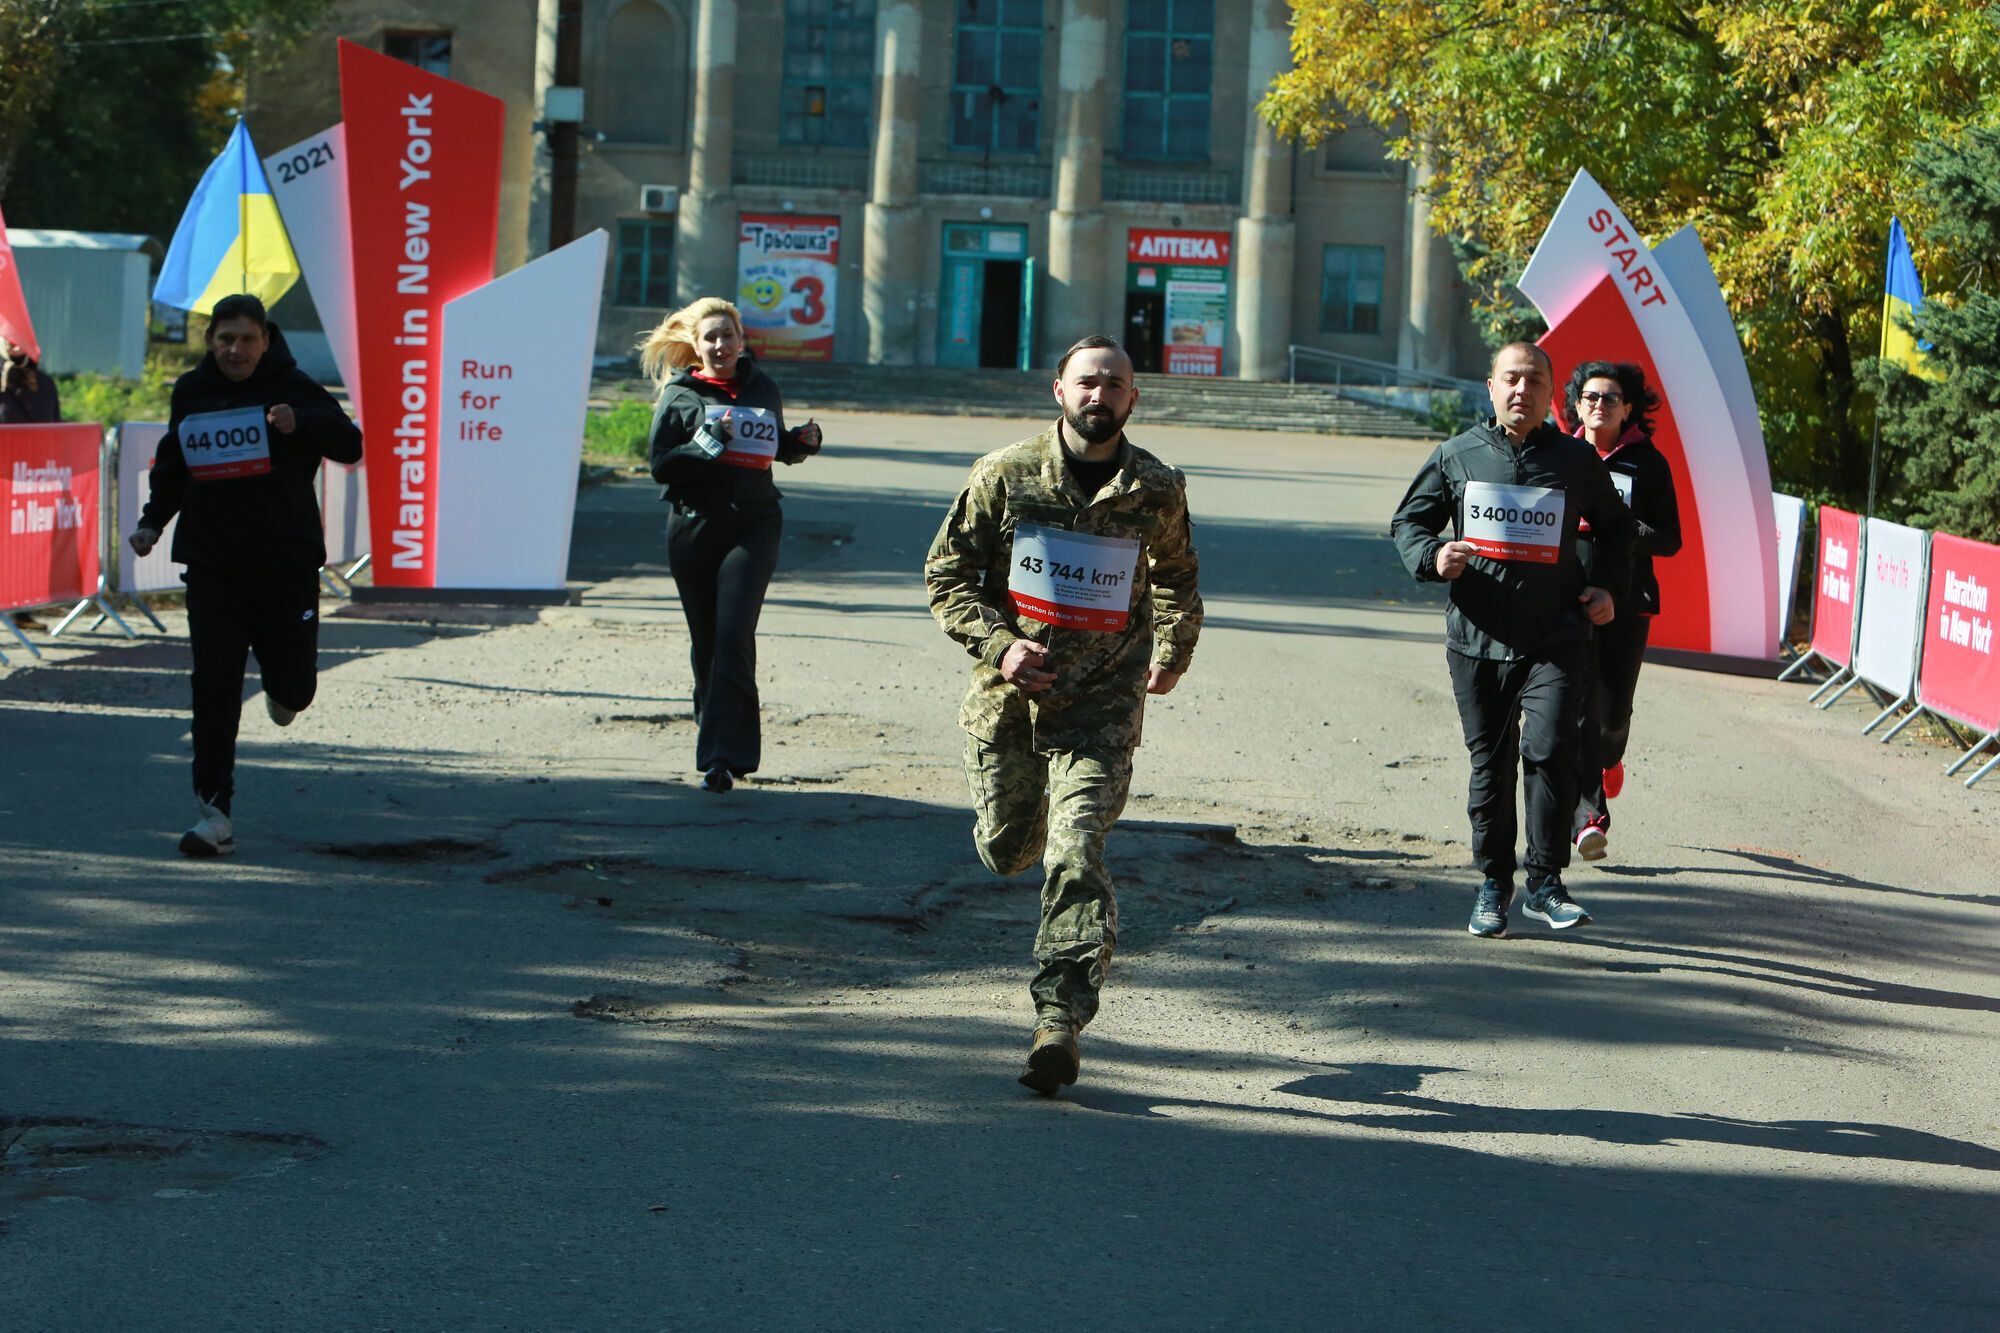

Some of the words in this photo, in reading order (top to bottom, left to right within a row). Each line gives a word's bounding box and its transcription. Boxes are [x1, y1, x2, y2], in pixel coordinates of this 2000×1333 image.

[400, 92, 433, 191] York
[278, 141, 335, 184] 2021
[397, 201, 431, 294] New
[1138, 235, 1218, 259] АПТЕКА
[1588, 208, 1667, 307] START
[790, 276, 825, 325] 3
[394, 309, 429, 346] in
[462, 360, 513, 380] Run
[460, 391, 501, 410] for
[187, 432, 212, 452] 44
[215, 425, 261, 449] 000
[461, 421, 503, 441] life
[740, 420, 775, 442] 022
[12, 460, 73, 494] Marathon
[391, 360, 428, 568] Marathon
[11, 498, 25, 535] in
[27, 499, 55, 533] New
[1471, 505, 1480, 519] 3
[1483, 507, 1518, 523] 400
[1522, 510, 1555, 527] 000
[1020, 556, 1043, 574] 43
[1049, 562, 1084, 582] 744
[1824, 537, 1848, 571] Marathon
[1944, 569, 1988, 613] Marathon
[1016, 601, 1046, 614] Marathon
[1055, 611, 1073, 621] New
[1073, 614, 1089, 622] York
[1940, 604, 1950, 641] in
[1949, 609, 1971, 647] New
[1971, 616, 1993, 655] York
